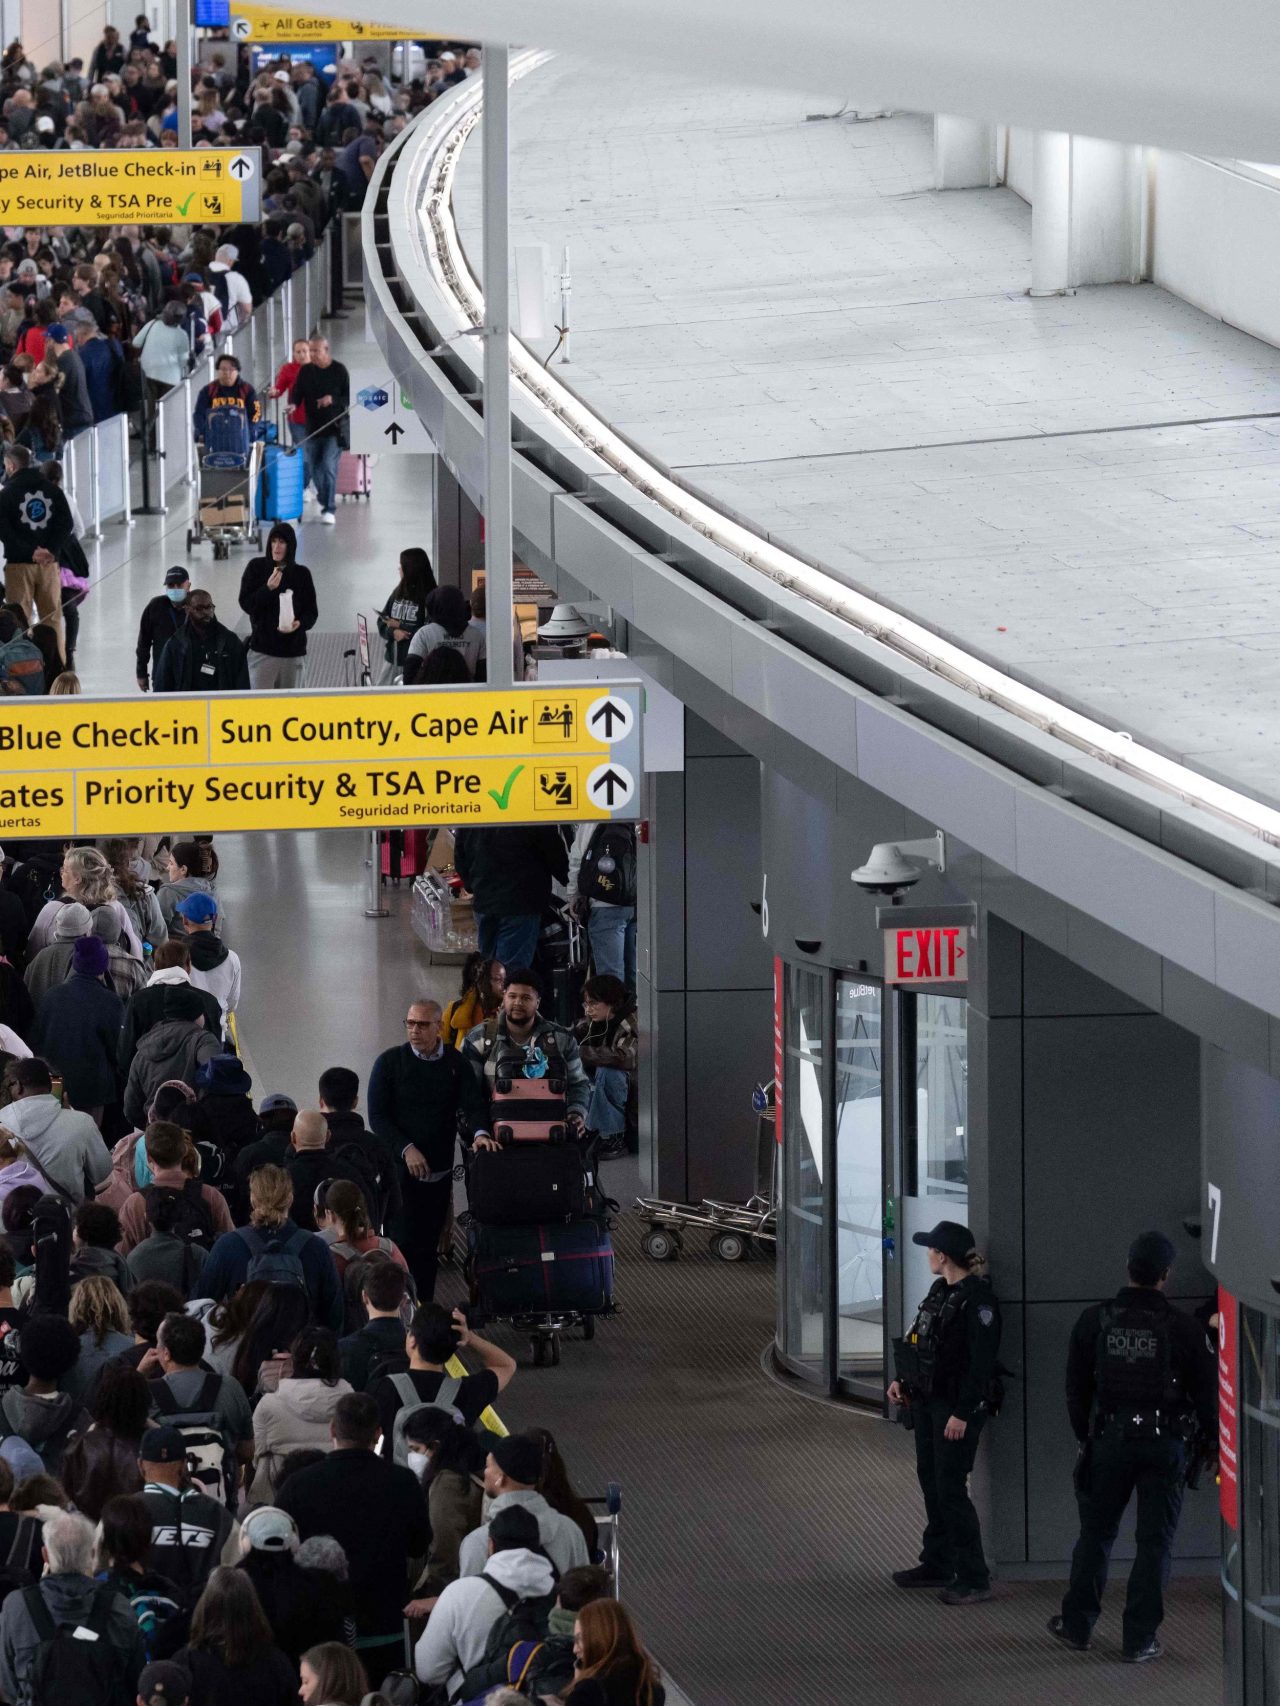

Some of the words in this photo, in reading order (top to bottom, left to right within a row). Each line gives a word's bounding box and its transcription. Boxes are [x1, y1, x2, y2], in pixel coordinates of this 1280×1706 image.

[276, 18, 292, 29] All
[296, 18, 331, 29] Gates
[24, 164, 52, 180] Air,
[57, 162, 119, 178] JetBlue
[124, 161, 197, 177] Check-in
[16, 195, 85, 213] Security
[90, 195, 102, 209] &
[107, 194, 140, 209] TSA
[146, 193, 173, 208] Pre
[96, 211, 134, 220] Seguridad
[136, 210, 174, 219] Prioritaria
[72, 720, 199, 749] Check-in
[221, 718, 272, 745] Sun
[282, 714, 400, 746] Country,
[410, 712, 479, 740] Cape
[488, 710, 529, 736] Air
[86, 778, 194, 811] Priority
[205, 774, 325, 807] Security
[336, 772, 357, 798] &
[366, 771, 425, 797] TSA
[435, 769, 481, 794] Pre
[339, 804, 410, 819] Seguridad
[413, 801, 481, 815] Prioritaria
[762, 873, 769, 938] 6
[896, 929, 960, 978] EXIT
[1208, 1182, 1221, 1265] 7
[1106, 1335, 1158, 1352] POLICE
